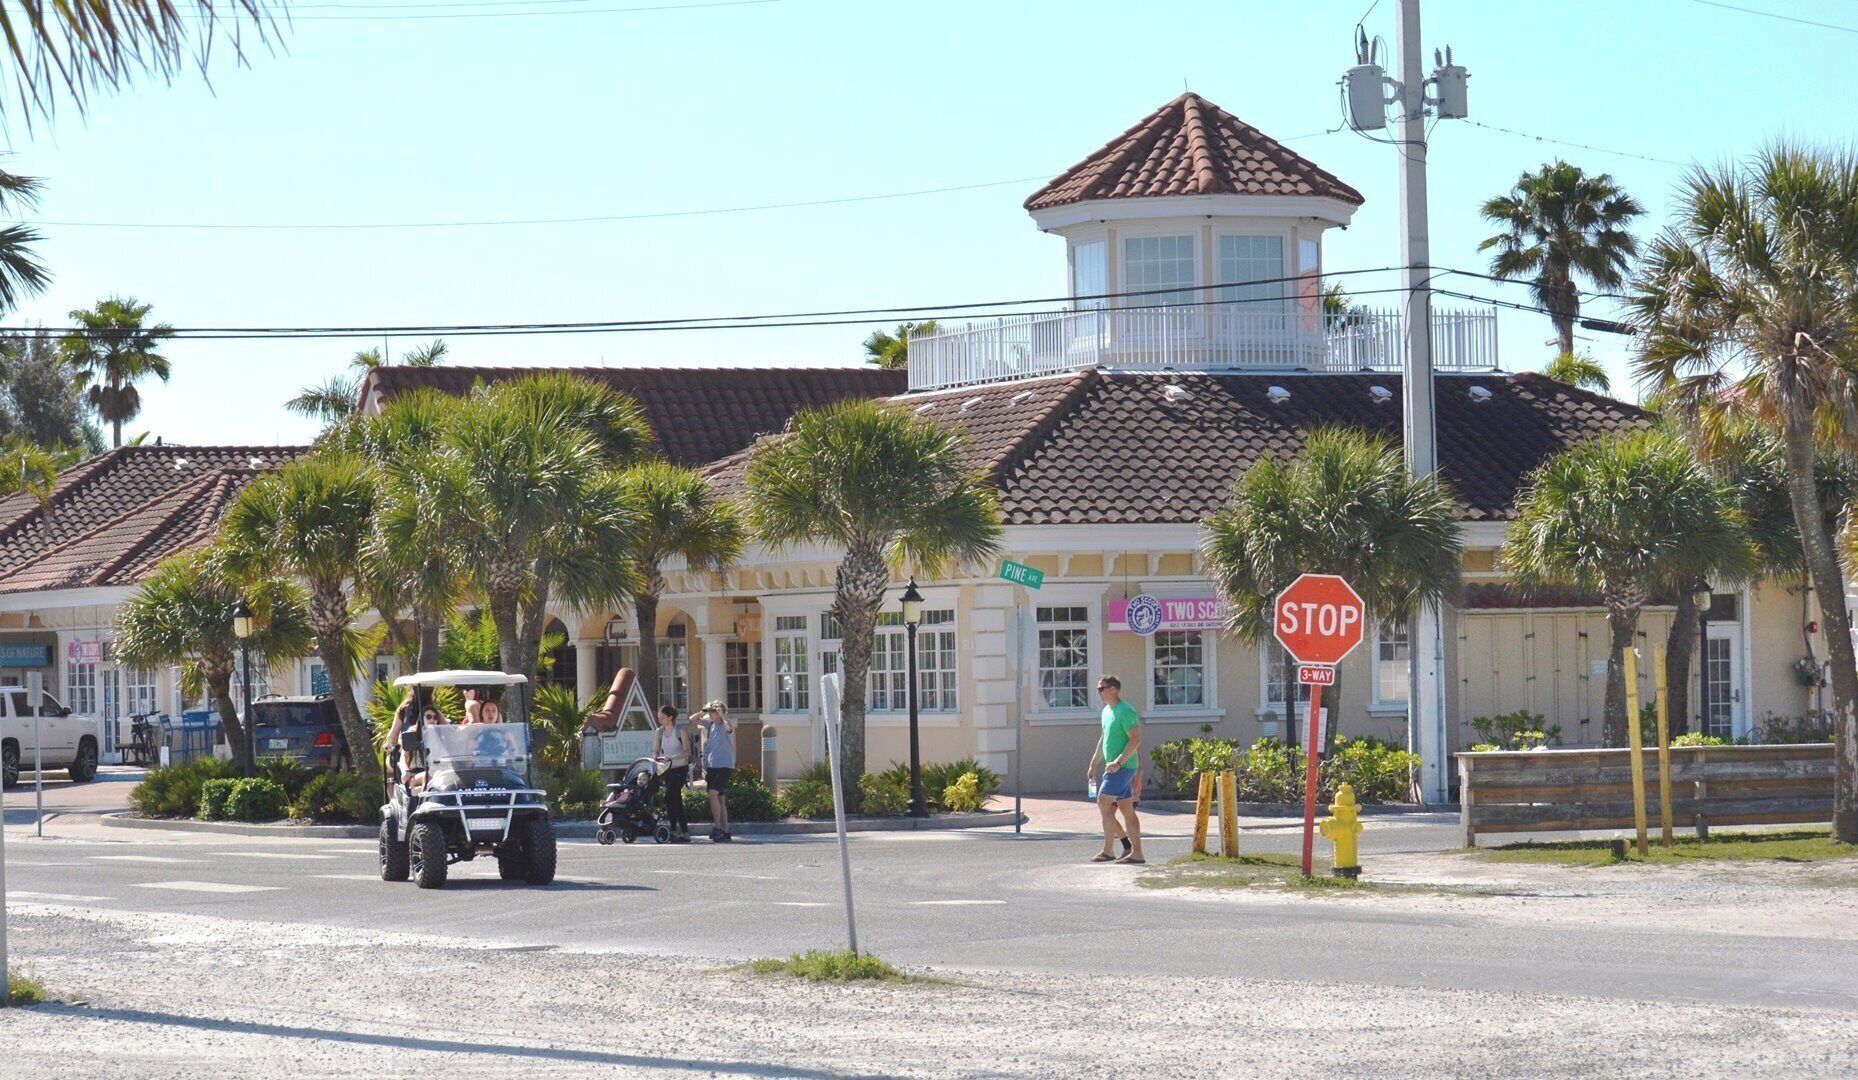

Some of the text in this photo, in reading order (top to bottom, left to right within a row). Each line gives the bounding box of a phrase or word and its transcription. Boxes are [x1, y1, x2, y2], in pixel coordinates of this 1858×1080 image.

[1005, 563, 1027, 582] PINE
[1129, 598, 1140, 610] TWO
[1166, 601, 1195, 620] TWO
[1280, 601, 1359, 637] STOP
[1301, 669, 1332, 682] 3-WAY
